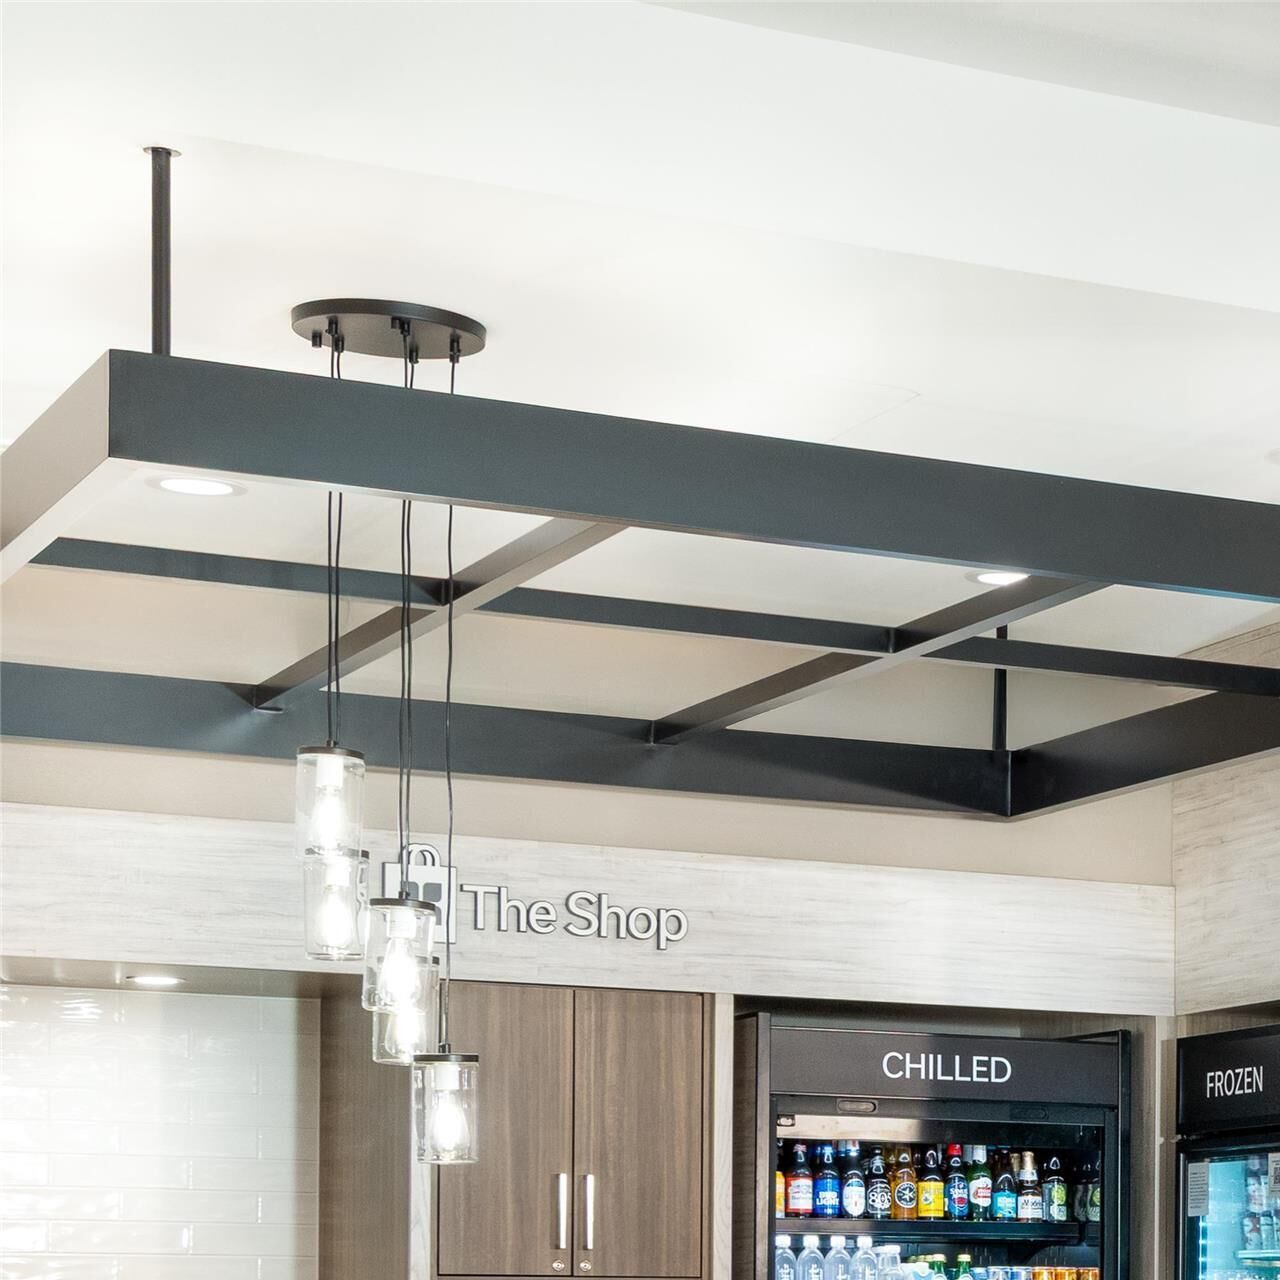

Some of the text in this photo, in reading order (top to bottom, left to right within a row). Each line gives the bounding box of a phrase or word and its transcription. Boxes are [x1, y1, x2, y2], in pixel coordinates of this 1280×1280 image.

[460, 883, 689, 950] The Shop
[882, 1051, 1012, 1083] CHILLED
[1206, 1065, 1264, 1098] FROZEN
